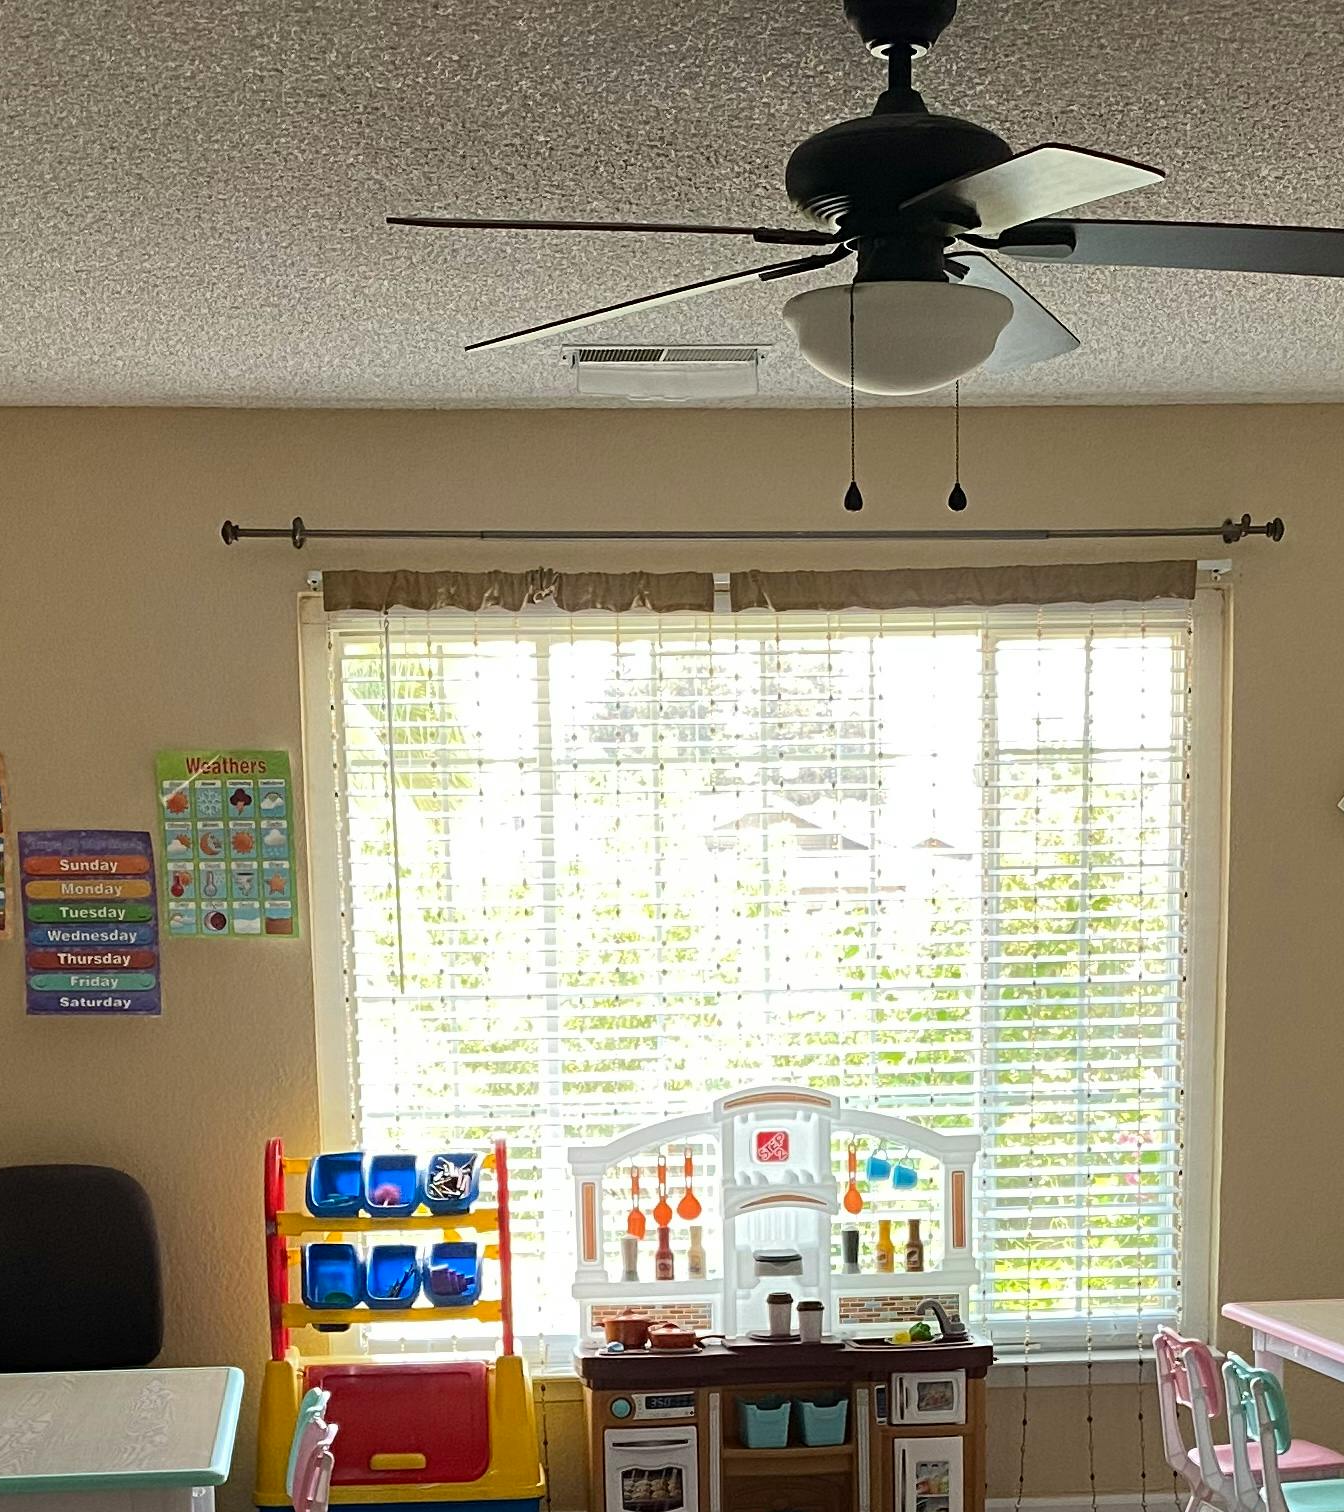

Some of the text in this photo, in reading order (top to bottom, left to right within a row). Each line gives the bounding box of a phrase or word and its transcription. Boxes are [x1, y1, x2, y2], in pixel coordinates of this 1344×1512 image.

[186, 757, 267, 774] Weathers
[59, 859, 118, 872] Sunday
[61, 884, 122, 896] Monday
[60, 907, 126, 919] Tuesday
[47, 930, 137, 943] Wednesday
[57, 953, 131, 966] Thursday
[70, 976, 119, 989] Friday
[60, 997, 131, 1009] Saturday
[758, 1132, 784, 1160] STEP
